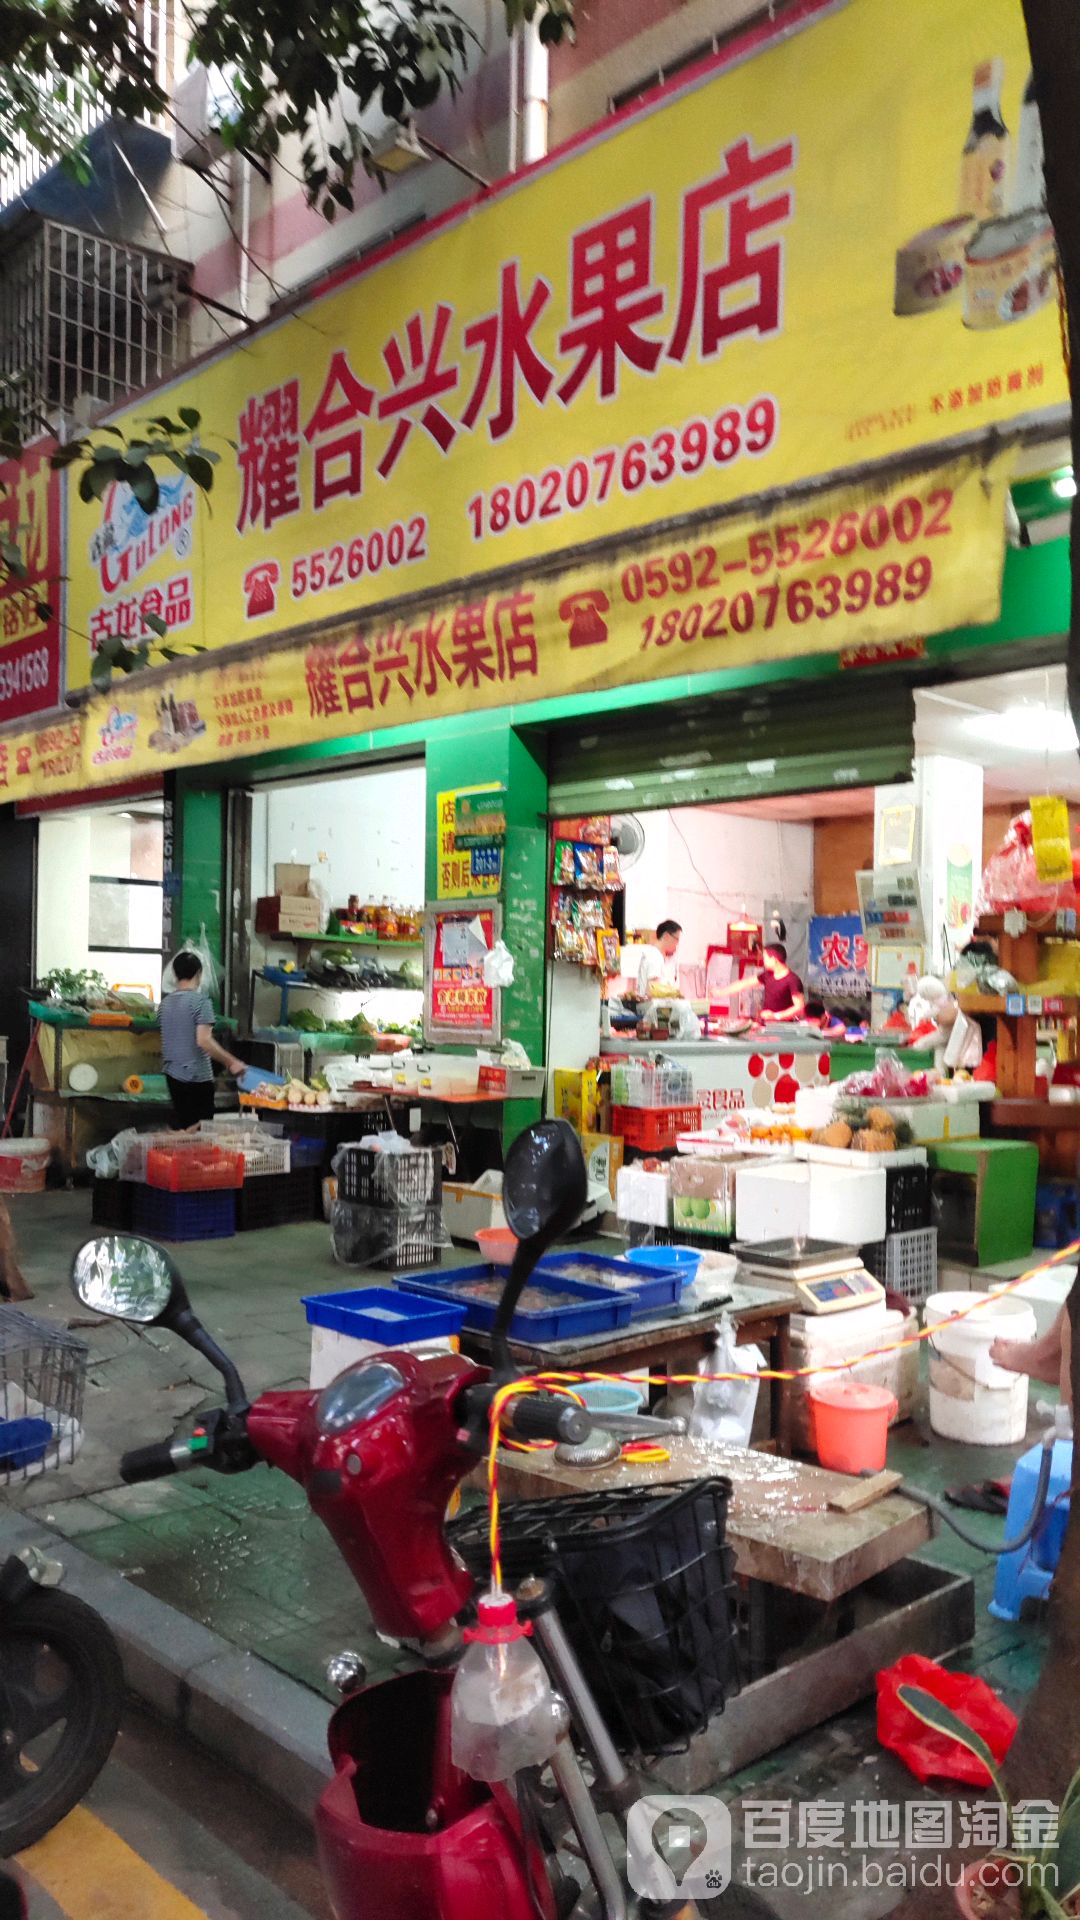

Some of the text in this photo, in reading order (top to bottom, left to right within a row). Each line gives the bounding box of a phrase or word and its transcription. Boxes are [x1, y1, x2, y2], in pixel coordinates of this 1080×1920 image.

[236, 138, 794, 533] 耀合兴水果店
[291, 399, 776, 598] 5526002 18020763989
[620, 489, 954, 604] 0592-5526002
[304, 592, 539, 719] 耀合兴水果店
[639, 555, 933, 651] 18020763989
